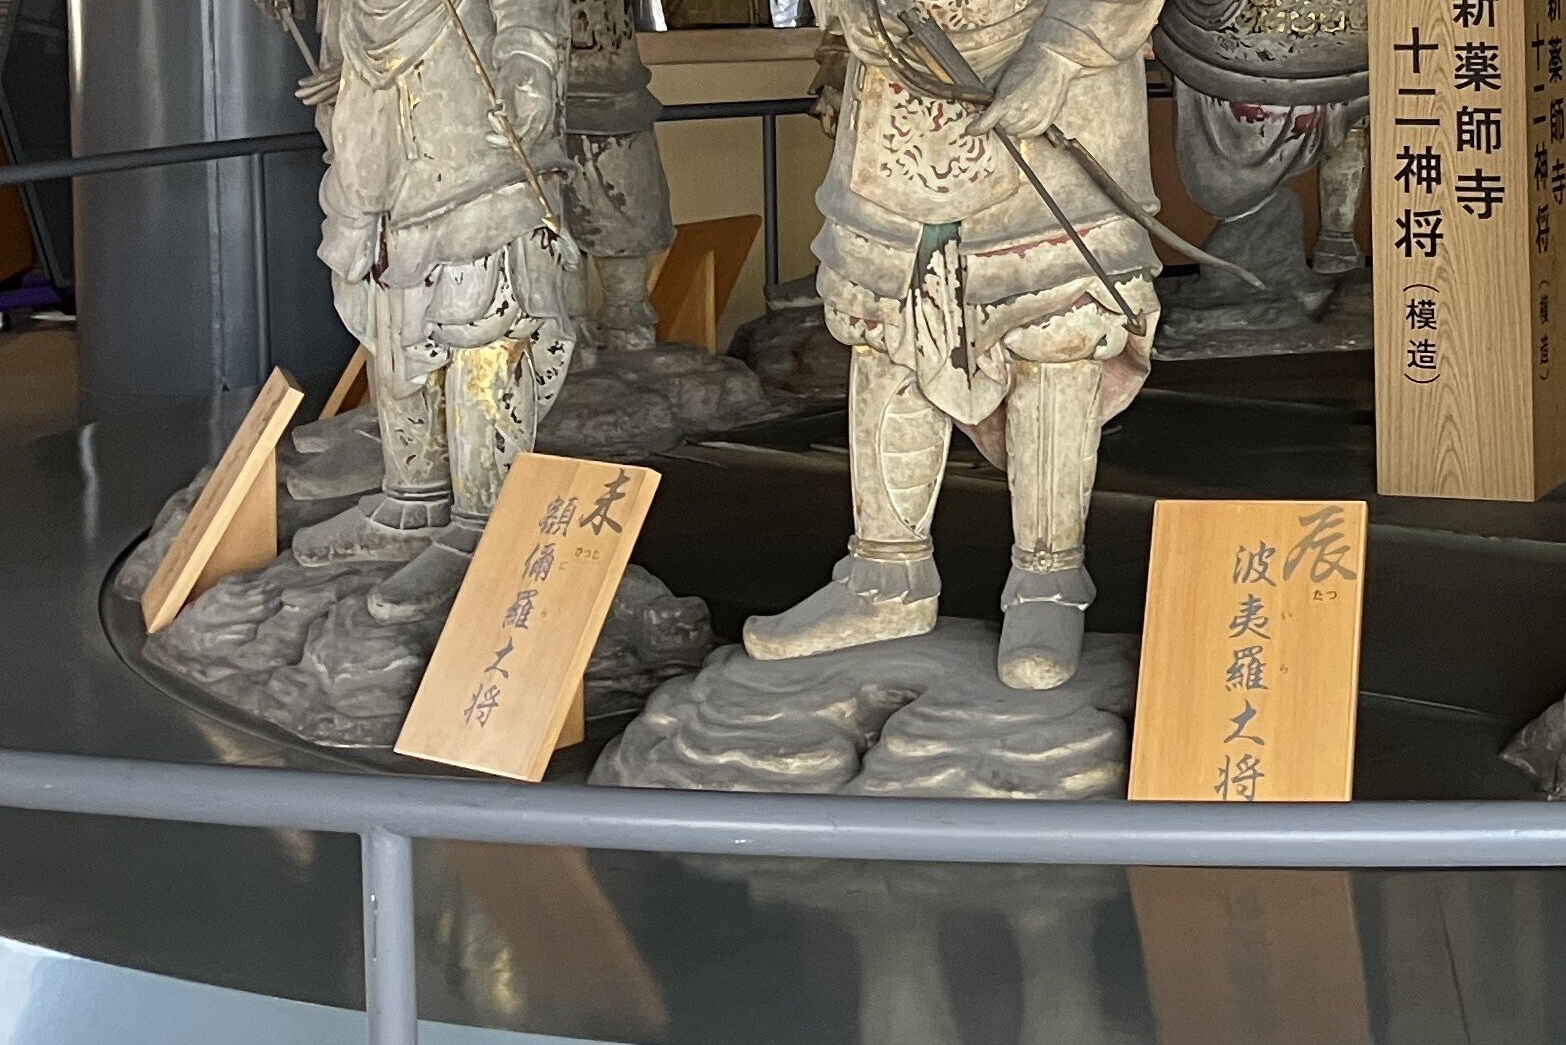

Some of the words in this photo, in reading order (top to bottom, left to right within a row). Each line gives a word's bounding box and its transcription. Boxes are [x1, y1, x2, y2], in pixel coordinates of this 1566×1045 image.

[1282, 505, 1357, 583] 辰
[1312, 589, 1338, 601] たつ
[1213, 540, 1278, 801] 波夷羅大将
